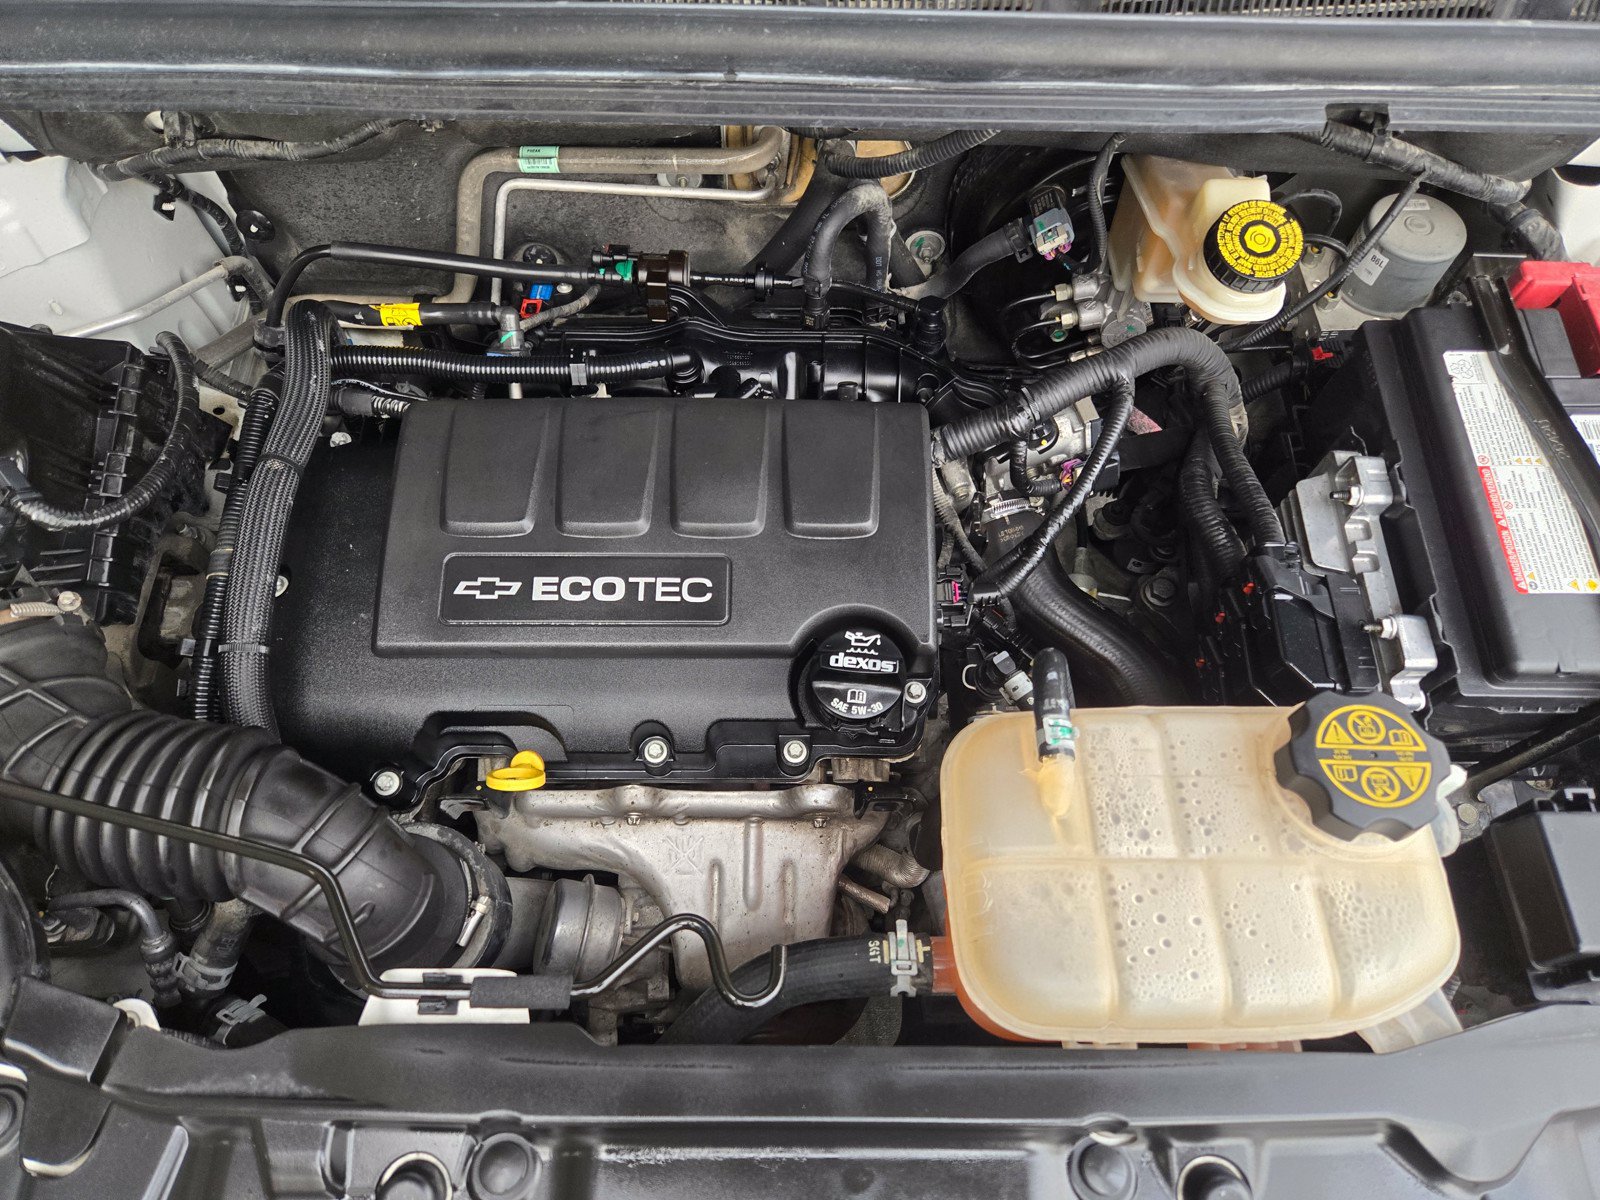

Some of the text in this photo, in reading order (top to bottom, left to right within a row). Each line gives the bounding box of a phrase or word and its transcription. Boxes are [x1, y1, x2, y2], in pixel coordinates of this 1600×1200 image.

[532, 576, 712, 602] ECOTEC
[830, 652, 898, 673] dexos
[830, 698, 884, 714] SAE 5W-30
